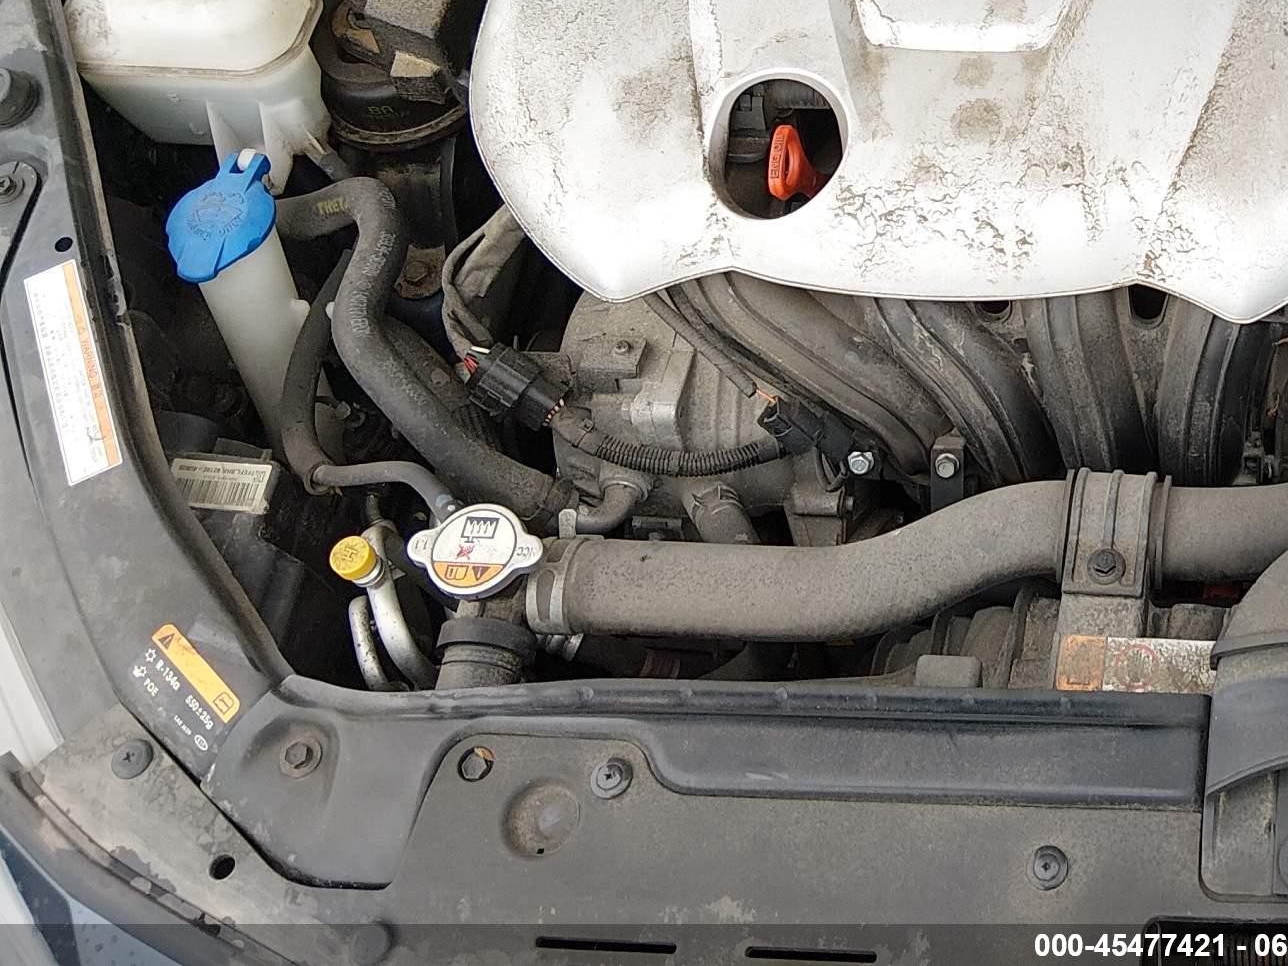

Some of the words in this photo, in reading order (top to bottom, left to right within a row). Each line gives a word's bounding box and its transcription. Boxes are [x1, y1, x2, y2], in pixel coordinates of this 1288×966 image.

[774, 135, 786, 153] OIL
[769, 155, 782, 180] ENG
[143, 677, 159, 697] POE
